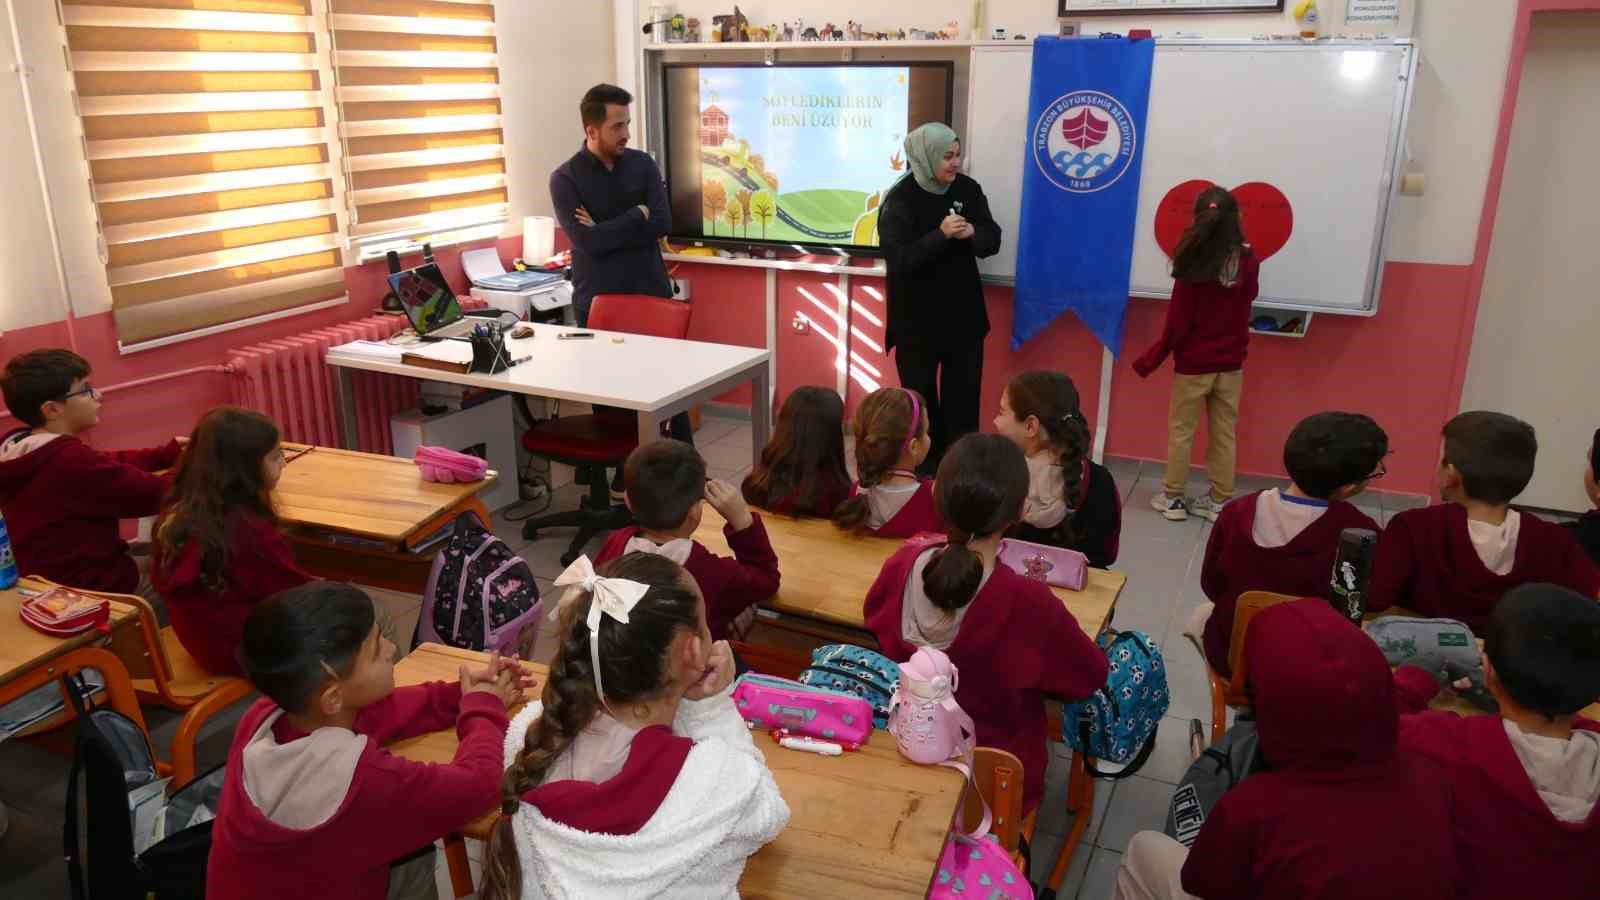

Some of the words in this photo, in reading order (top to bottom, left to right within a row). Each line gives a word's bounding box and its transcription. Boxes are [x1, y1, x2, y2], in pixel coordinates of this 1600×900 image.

[1038, 109, 1058, 151] TRABZON
[1057, 95, 1112, 112] BÜYÜKŞEHİR
[1110, 106, 1131, 156] BELEDİYESİ
